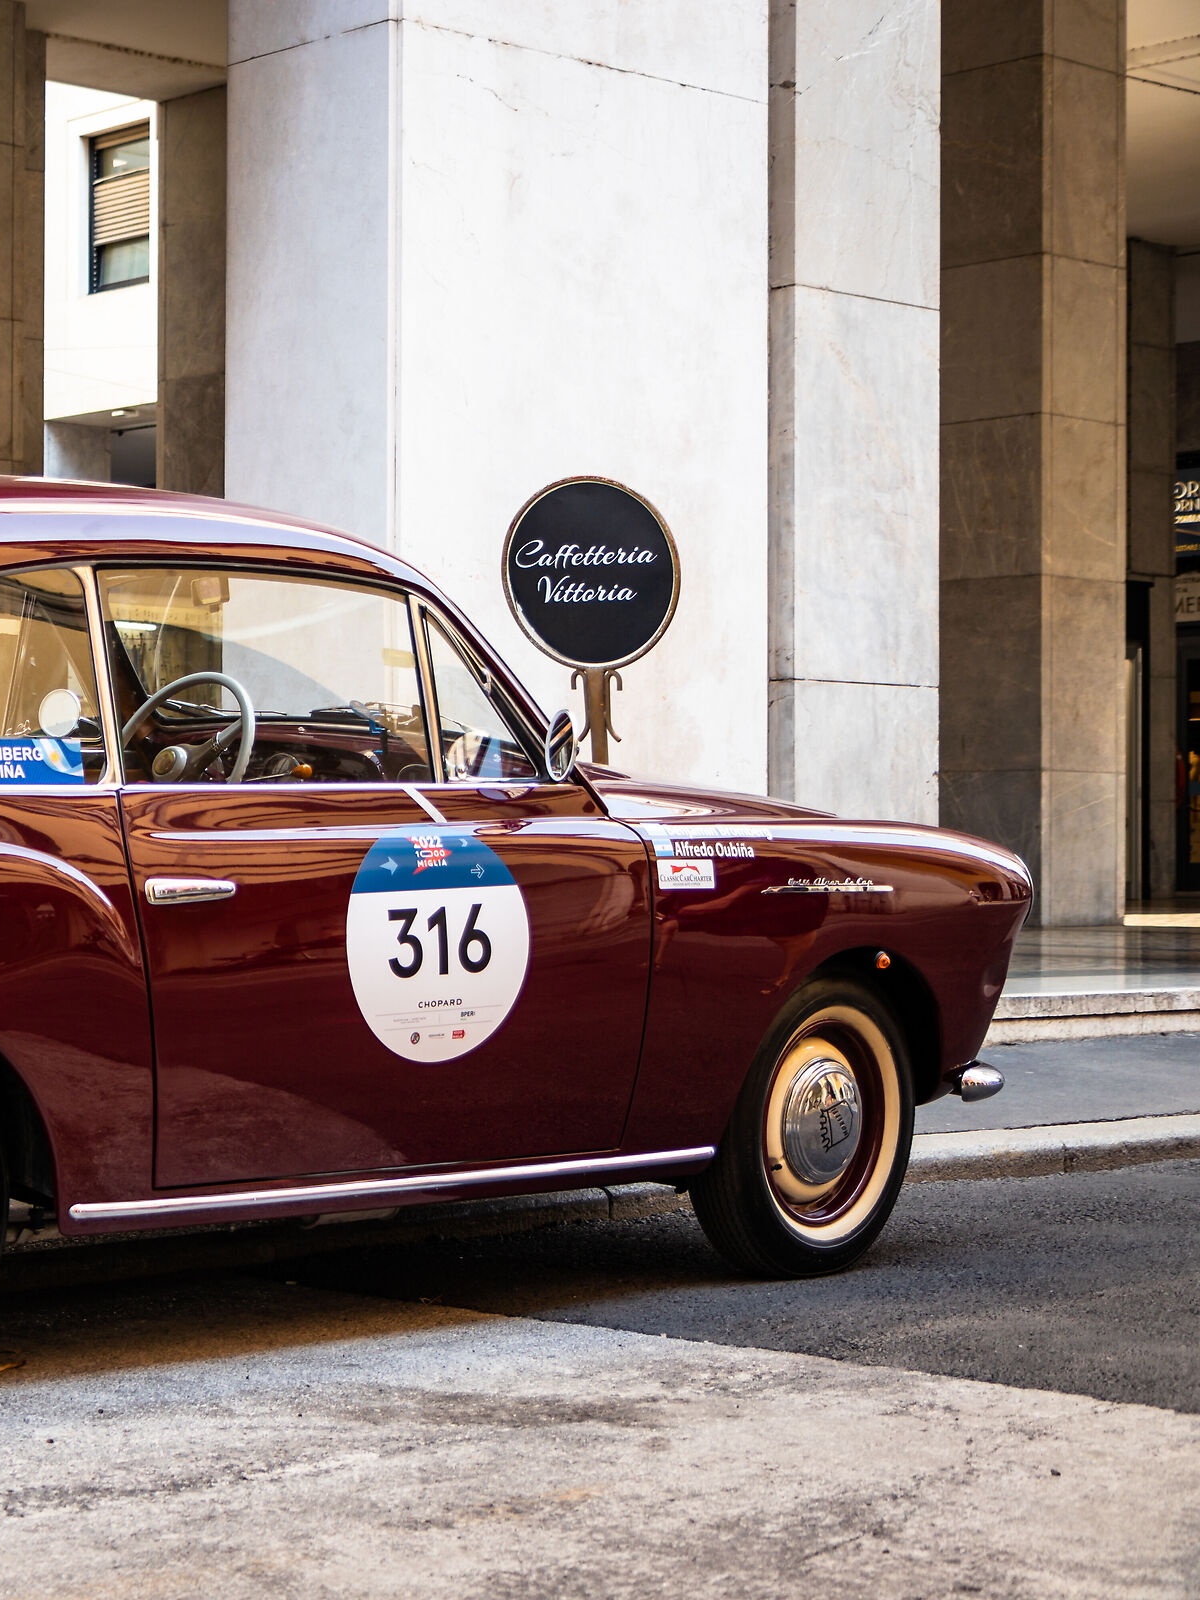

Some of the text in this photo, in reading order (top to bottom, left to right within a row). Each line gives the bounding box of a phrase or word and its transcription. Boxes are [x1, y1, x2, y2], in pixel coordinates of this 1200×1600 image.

[515, 539, 658, 569] Caffetteria
[537, 575, 638, 603] Vittoria
[411, 835, 443, 849] 2022
[674, 841, 755, 858] Alfredo Oubiña
[417, 859, 448, 868] MIGLIA
[387, 903, 492, 979] 316
[418, 998, 463, 1009] CHOPARD
